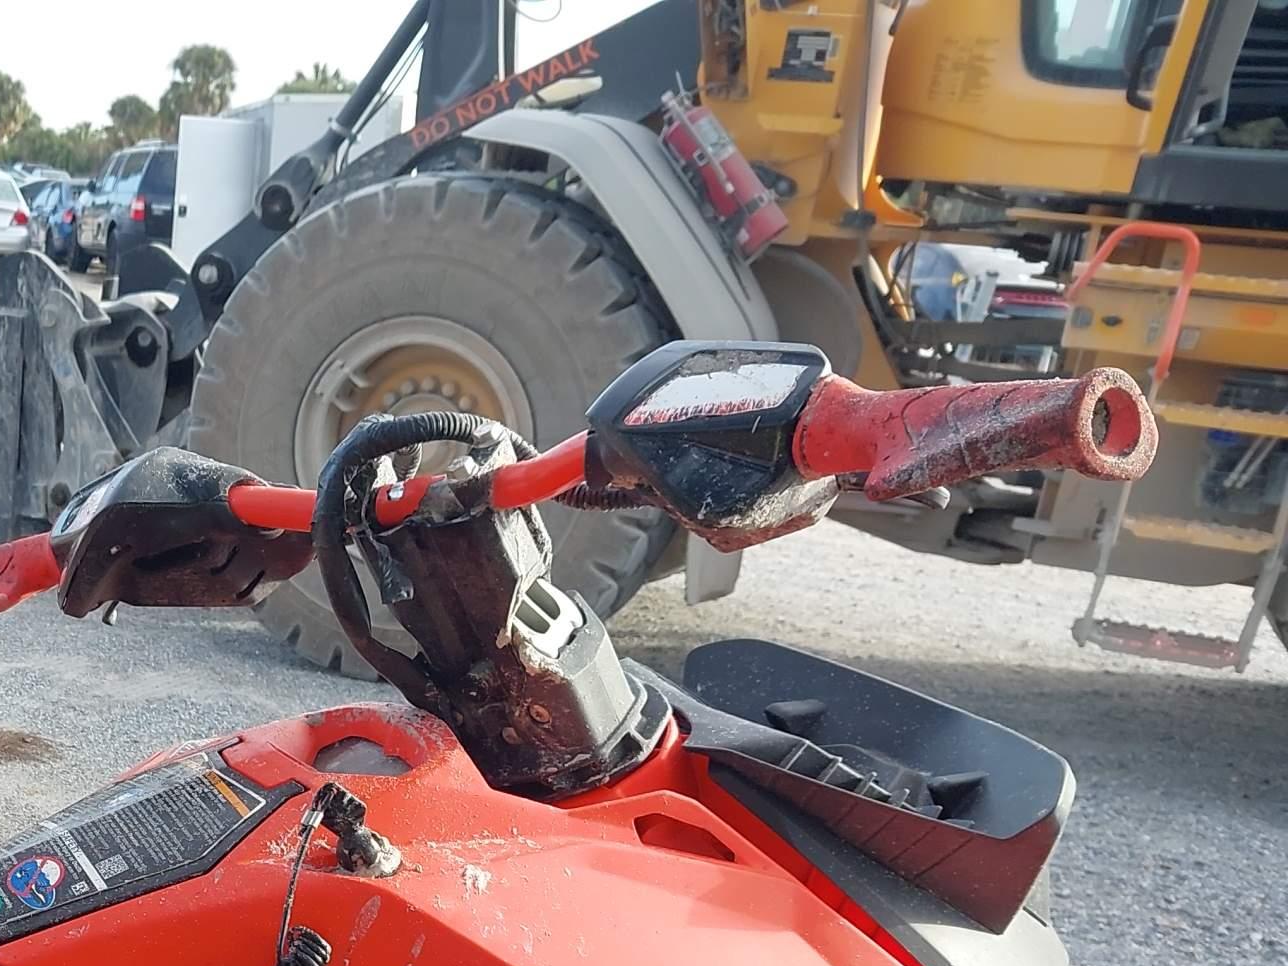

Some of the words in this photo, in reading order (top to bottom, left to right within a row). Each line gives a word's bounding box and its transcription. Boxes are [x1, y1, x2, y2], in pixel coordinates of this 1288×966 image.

[410, 117, 453, 152] DO
[454, 83, 512, 133] NOT
[520, 38, 601, 95] WALK
